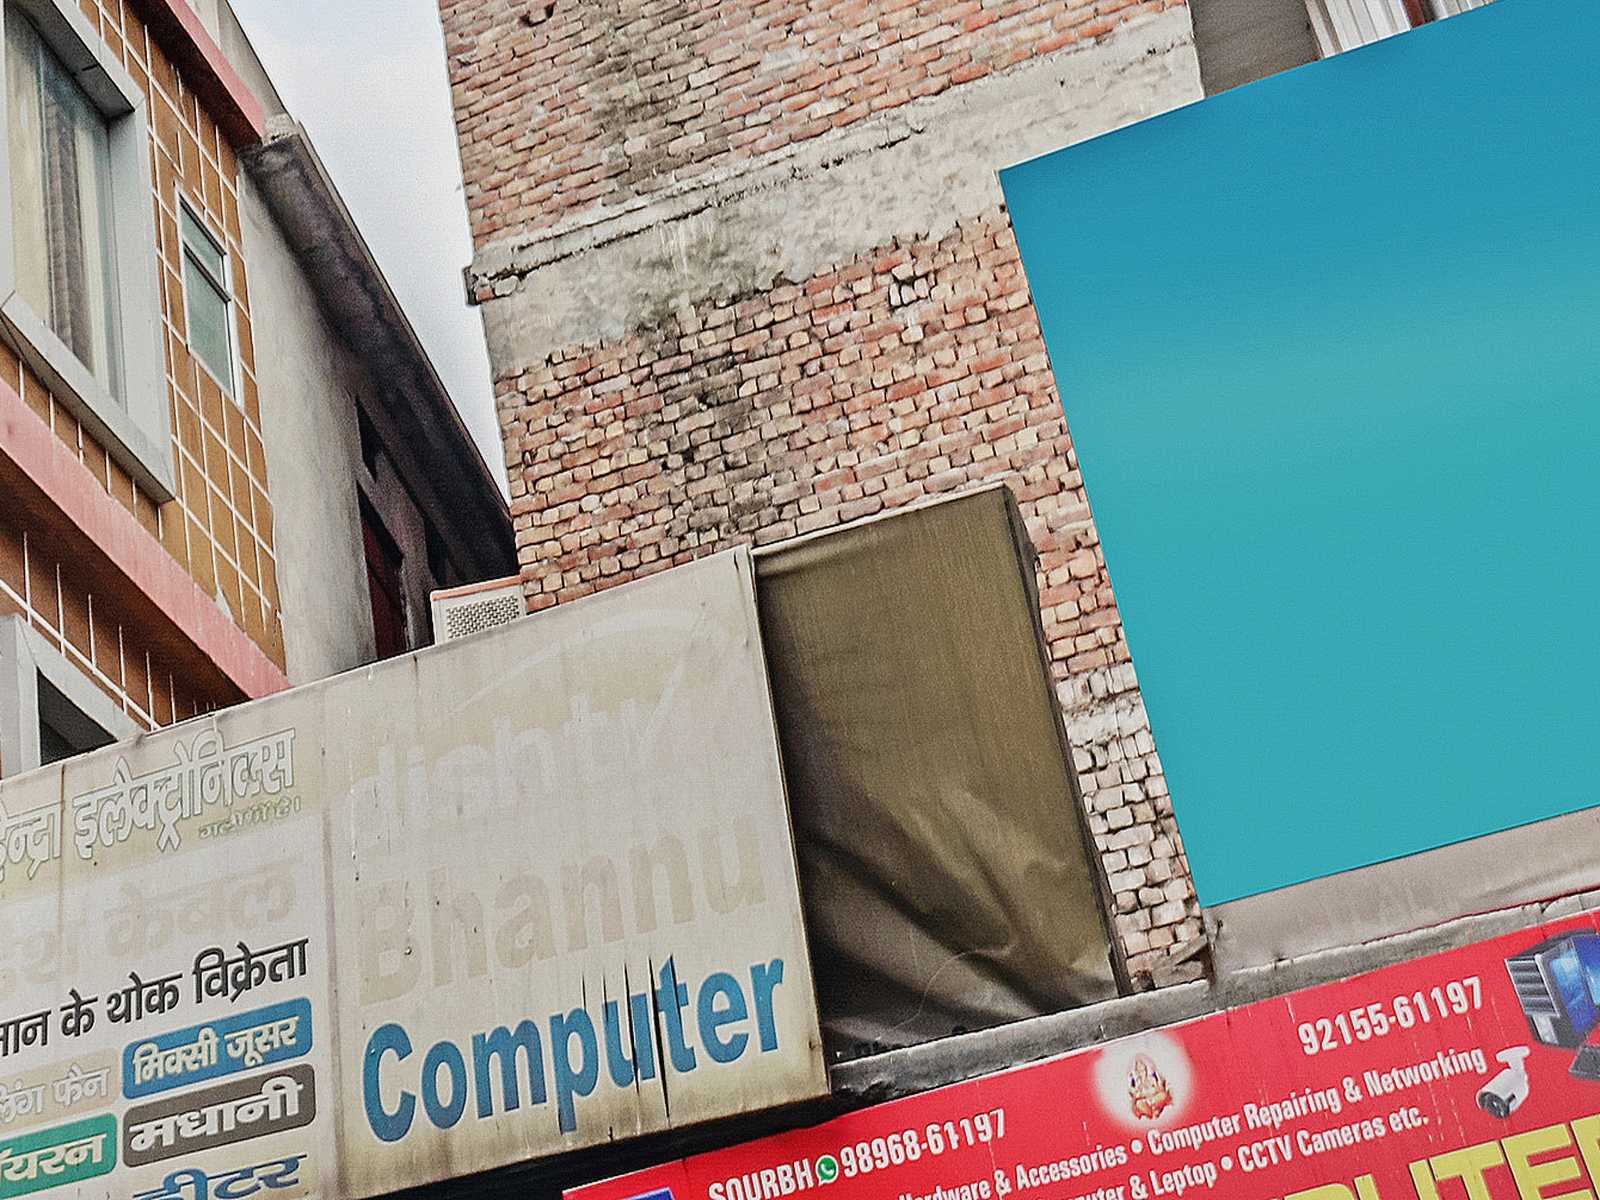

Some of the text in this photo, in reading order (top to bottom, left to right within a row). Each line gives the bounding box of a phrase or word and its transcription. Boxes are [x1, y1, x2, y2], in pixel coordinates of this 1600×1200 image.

[358, 816, 768, 1002] Bhannu
[60, 988, 98, 1037] के
[107, 971, 183, 1023] थोक
[192, 937, 309, 1003] विक्रेता
[1297, 975, 1482, 1055] 92155-61197
[133, 1015, 299, 1085] मिक्सी जूसर
[362, 956, 787, 1144] Computer
[708, 1108, 1006, 1200] SOURBH 98968-61197
[994, 1169, 1012, 1195] &
[1015, 1144, 1128, 1191] Accessories
[1147, 1109, 1242, 1155] Computer
[1245, 1087, 1342, 1130] Repairing
[1342, 1077, 1363, 1103] &
[1363, 1048, 1488, 1098] Networking
[1129, 1175, 1149, 1200] &
[1237, 1134, 1293, 1173] CCTV
[1296, 1119, 1386, 1156] Cameras
[1388, 1107, 1429, 1134] etc.
